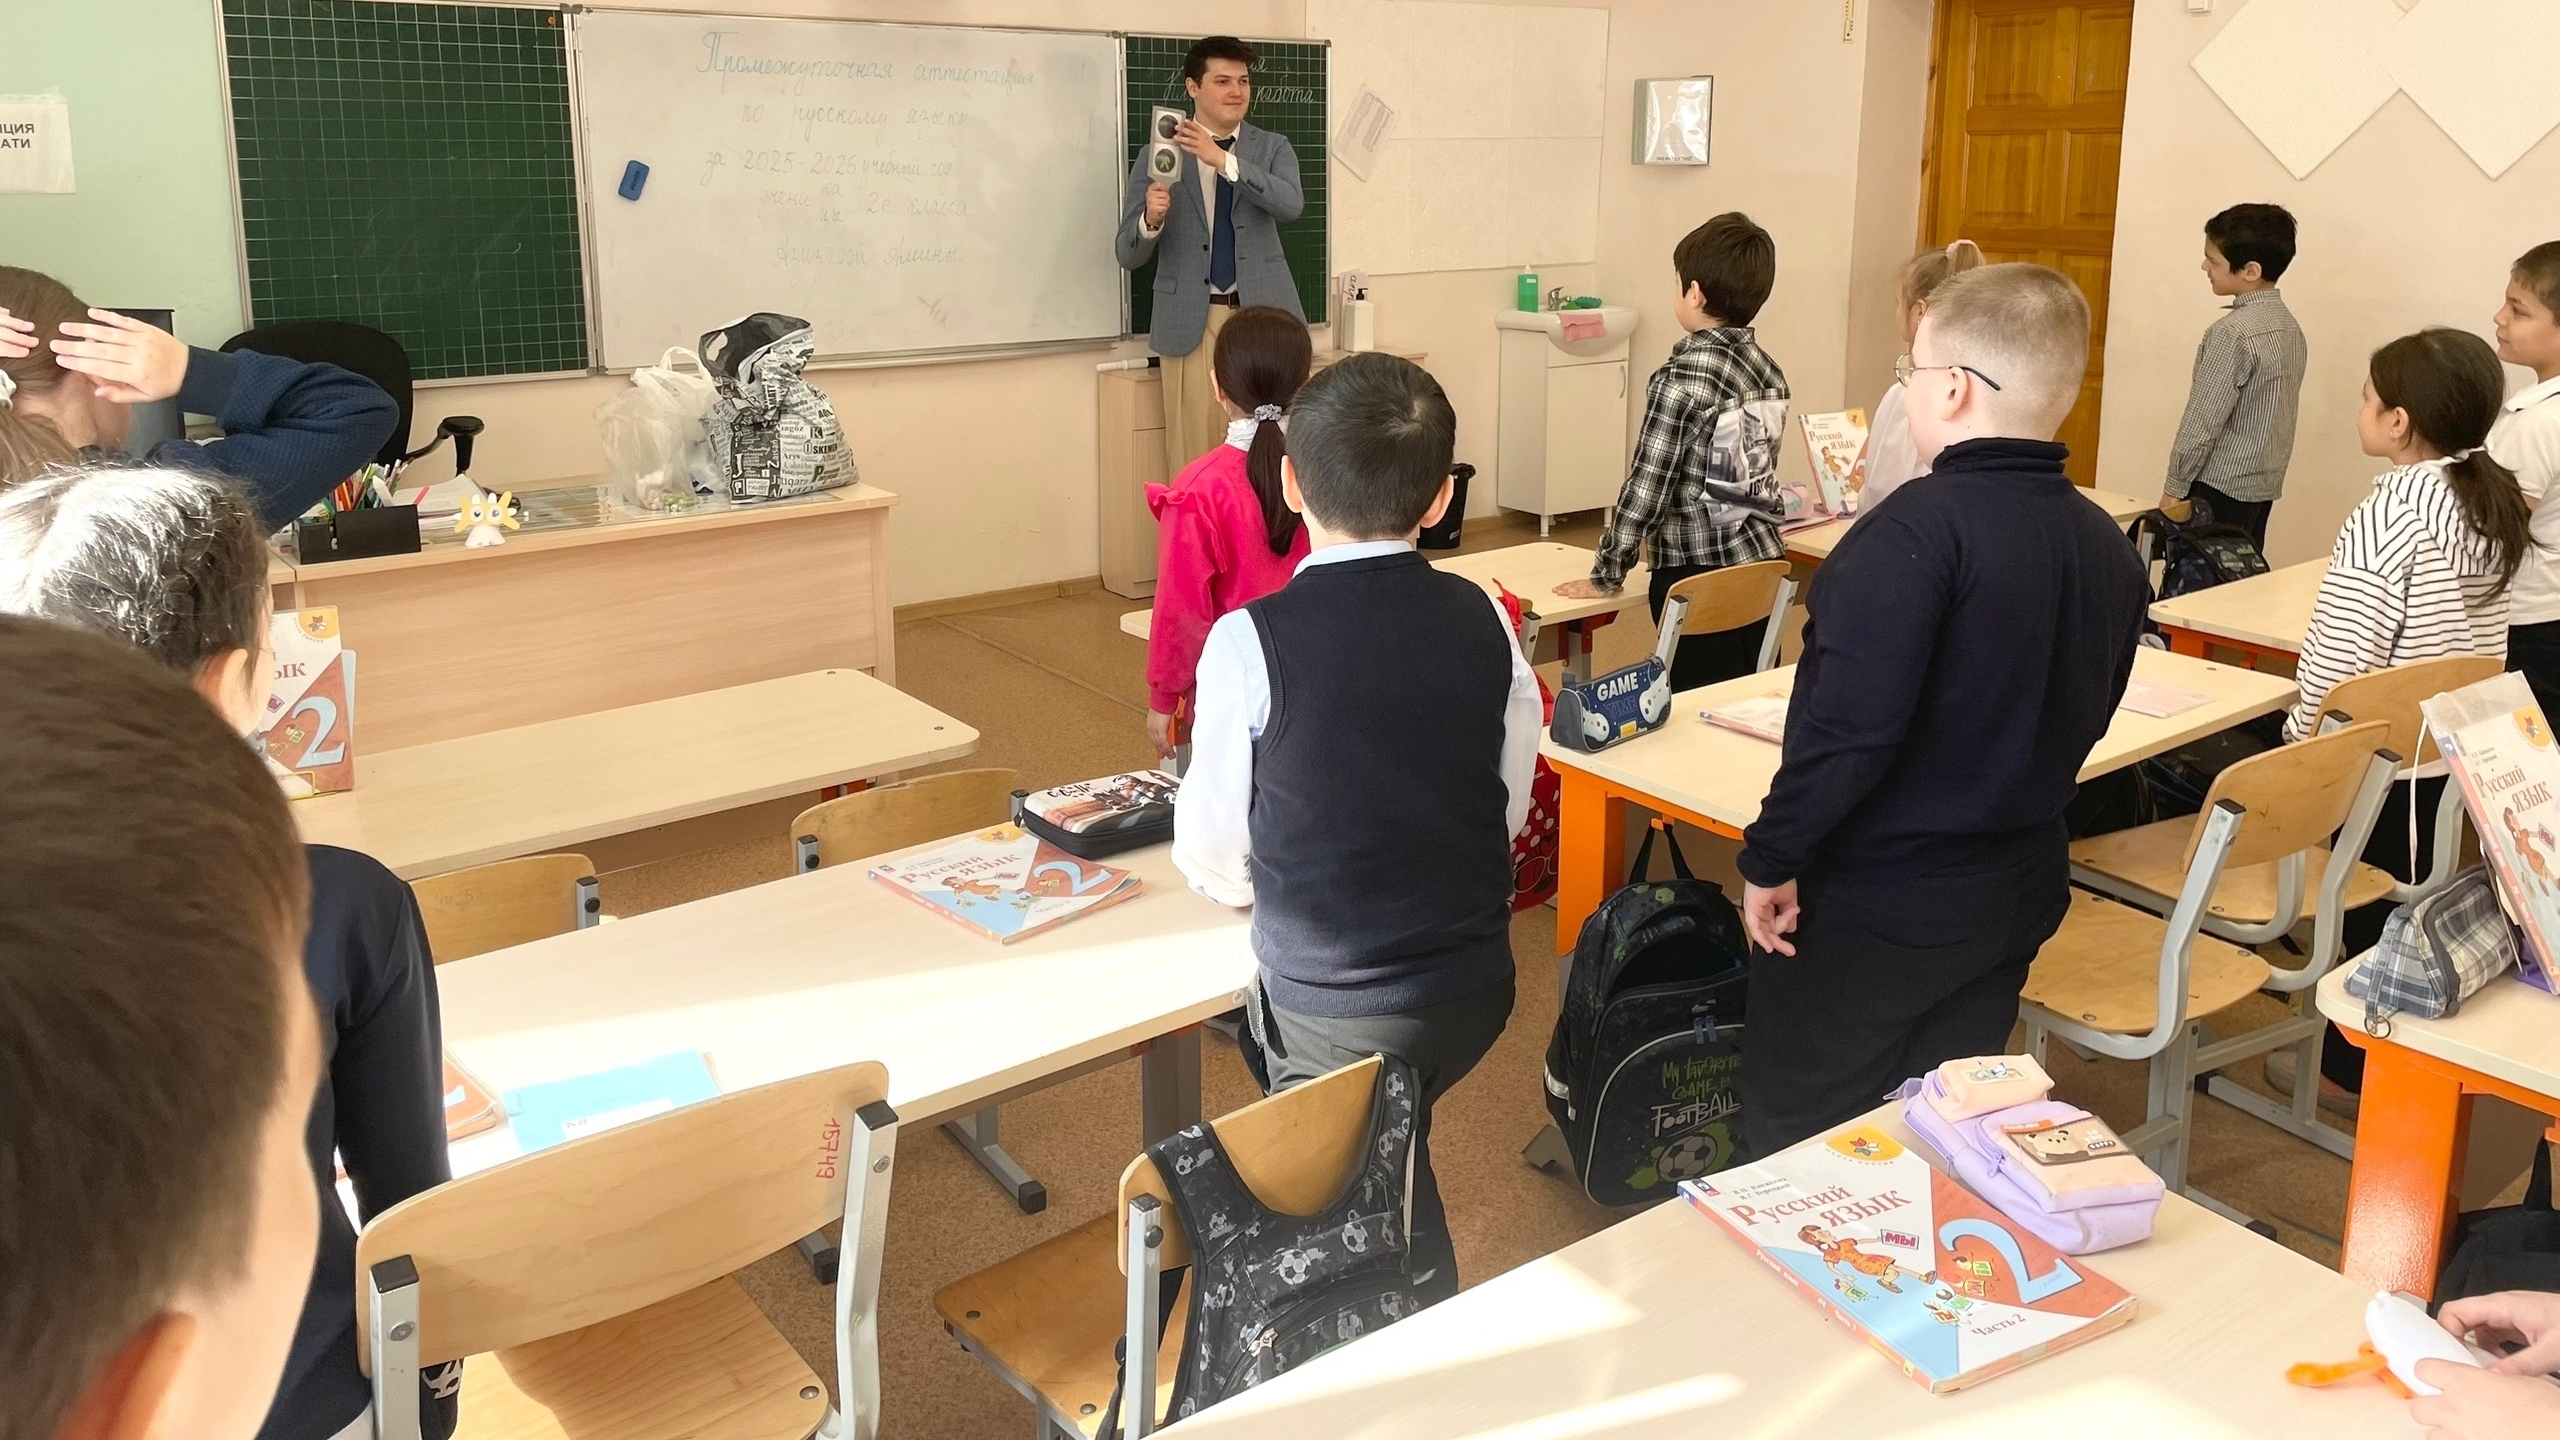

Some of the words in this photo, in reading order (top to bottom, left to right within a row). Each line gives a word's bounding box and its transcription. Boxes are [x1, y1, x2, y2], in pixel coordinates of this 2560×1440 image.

[696, 31, 895, 97] Промежуточная
[1251, 74, 1315, 115] работа
[740, 102, 765, 125] по
[700, 151, 726, 187] за
[858, 150, 922, 190] учебный
[906, 194, 970, 218] класса
[1808, 430, 1843, 443] Русский
[1830, 440, 1857, 450] ЯЗЫК
[1597, 671, 1639, 701] GAME
[1605, 695, 1639, 720] TIME
[291, 695, 346, 769] 2
[2472, 764, 2527, 800] Русский
[2511, 781, 2553, 814] ЯЗЫК
[900, 855, 985, 883] Русский
[959, 853, 1022, 876] ЯЗЫК
[1033, 861, 1113, 896] 2
[1671, 1078, 1715, 1100] GAME
[815, 1117, 841, 1179] 15749
[1727, 1184, 1855, 1227] Русский
[1819, 1189, 1914, 1228] ЯЗЫК
[1938, 1218, 2085, 1304] 2
[1971, 1316, 2014, 1340] Часть
[2015, 1313, 2027, 1325] 2
